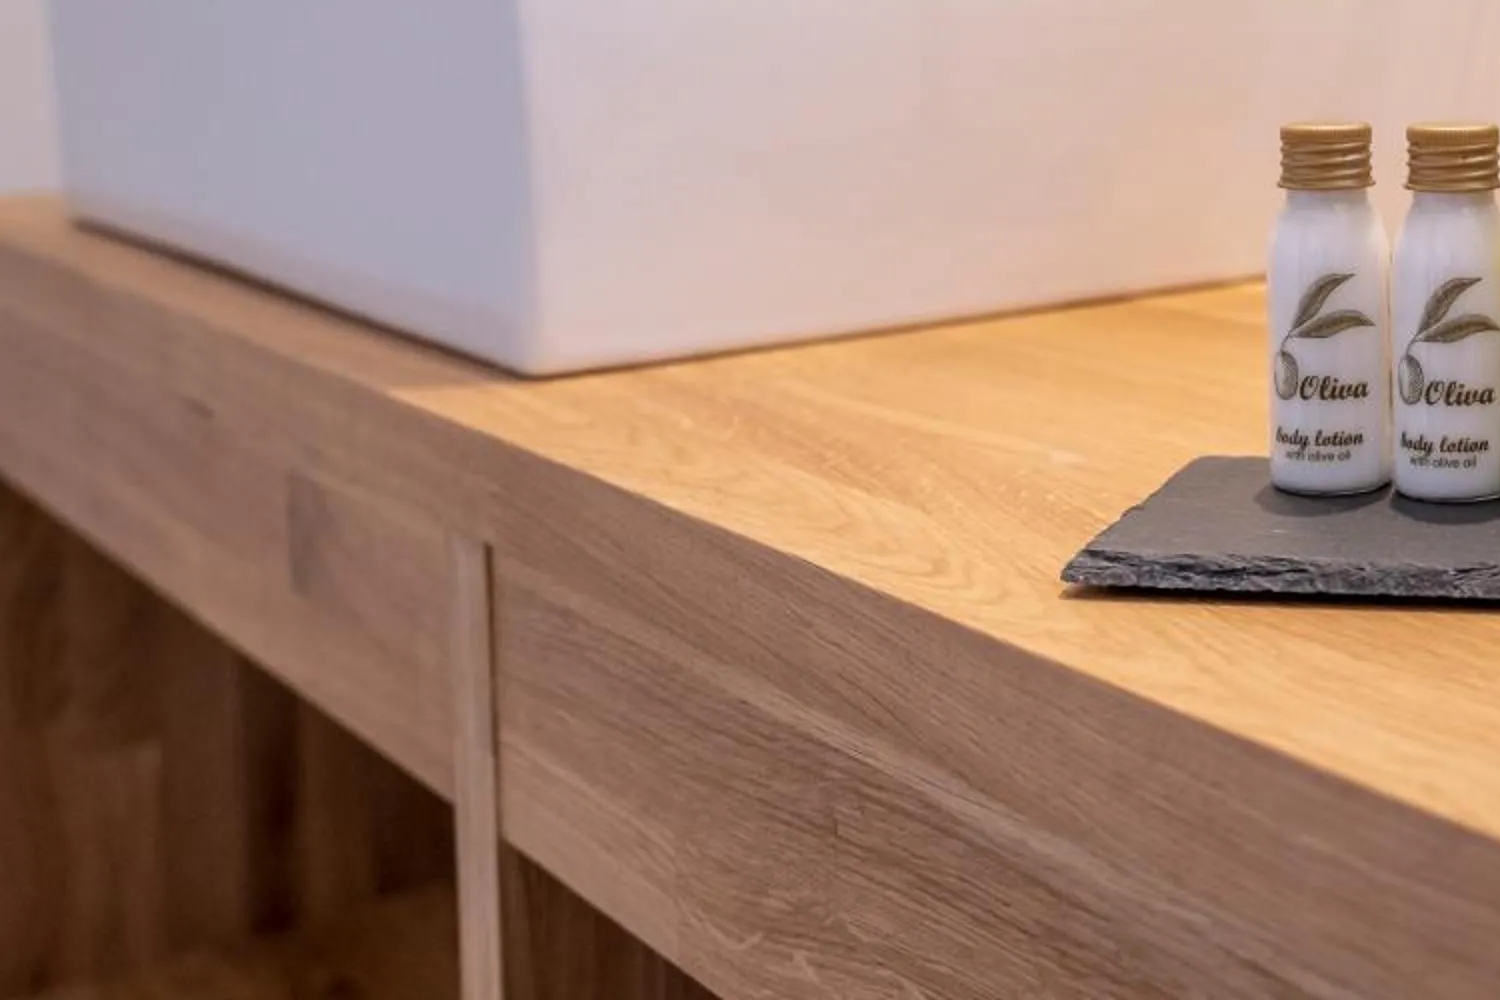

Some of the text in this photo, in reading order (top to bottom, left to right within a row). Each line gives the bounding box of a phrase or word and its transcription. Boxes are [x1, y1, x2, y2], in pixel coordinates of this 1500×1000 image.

[1300, 375, 1370, 402] Oliva
[1424, 380, 1495, 406] Oliva
[1275, 426, 1364, 451] body lotion
[1400, 431, 1489, 456] body lotion
